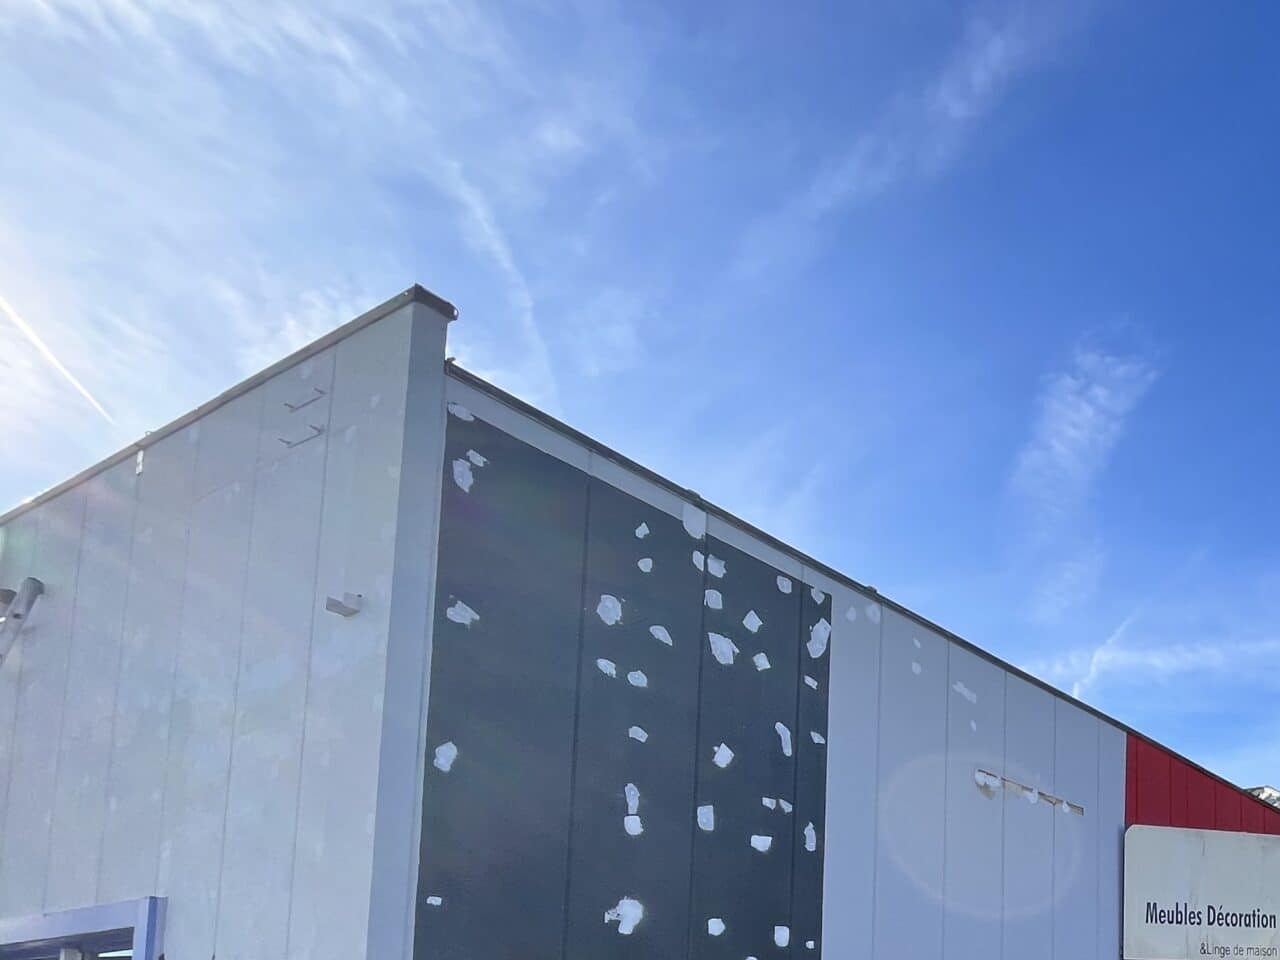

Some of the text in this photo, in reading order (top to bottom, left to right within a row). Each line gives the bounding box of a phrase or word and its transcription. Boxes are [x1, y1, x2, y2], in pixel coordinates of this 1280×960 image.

[1145, 902, 1203, 926] Meubles
[1207, 904, 1277, 929] Décoration
[1233, 944, 1244, 956] de
[1246, 945, 1278, 957] maison
